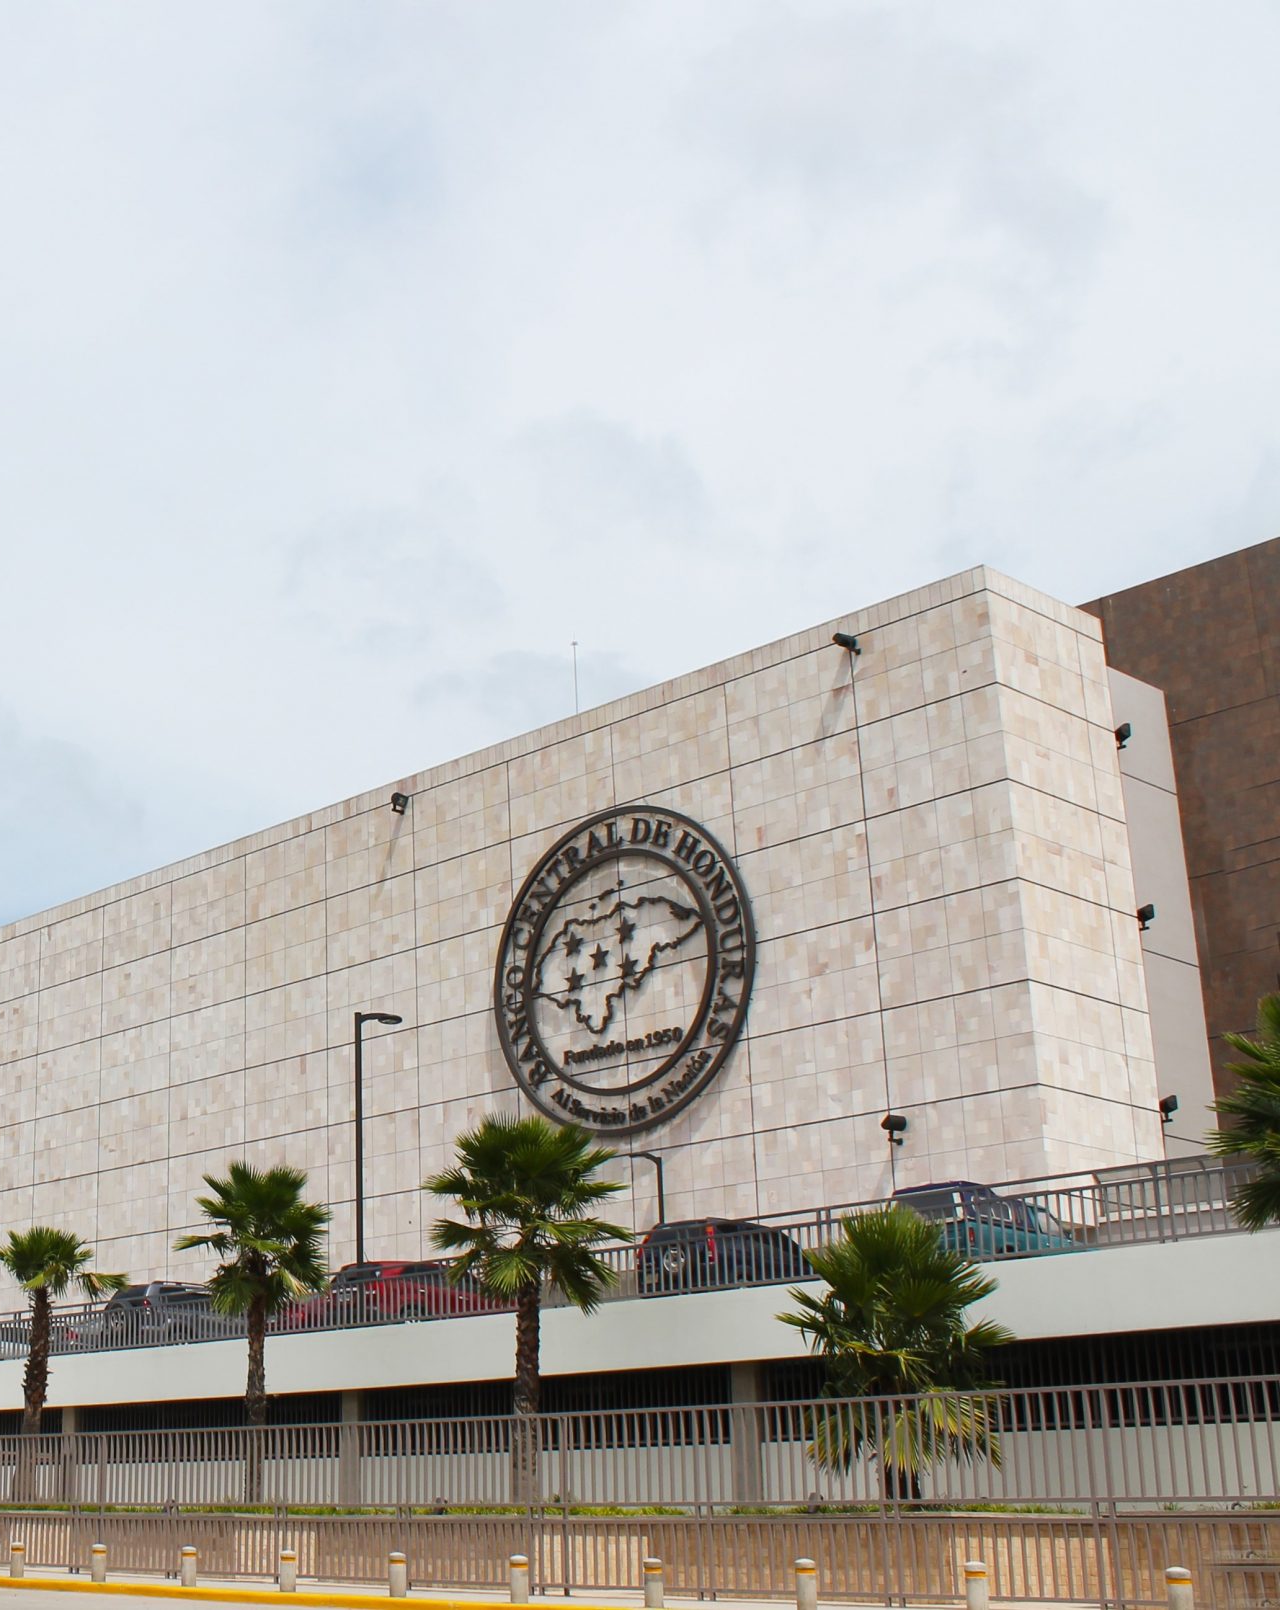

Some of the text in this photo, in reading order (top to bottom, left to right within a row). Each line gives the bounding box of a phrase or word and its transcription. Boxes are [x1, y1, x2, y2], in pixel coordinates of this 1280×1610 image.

[505, 816, 745, 1087] BANCO CENTRAL DE HONDURAS
[562, 1026, 684, 1066] Fundado en 1950
[550, 1050, 713, 1125] Al Servicio de la Nación
